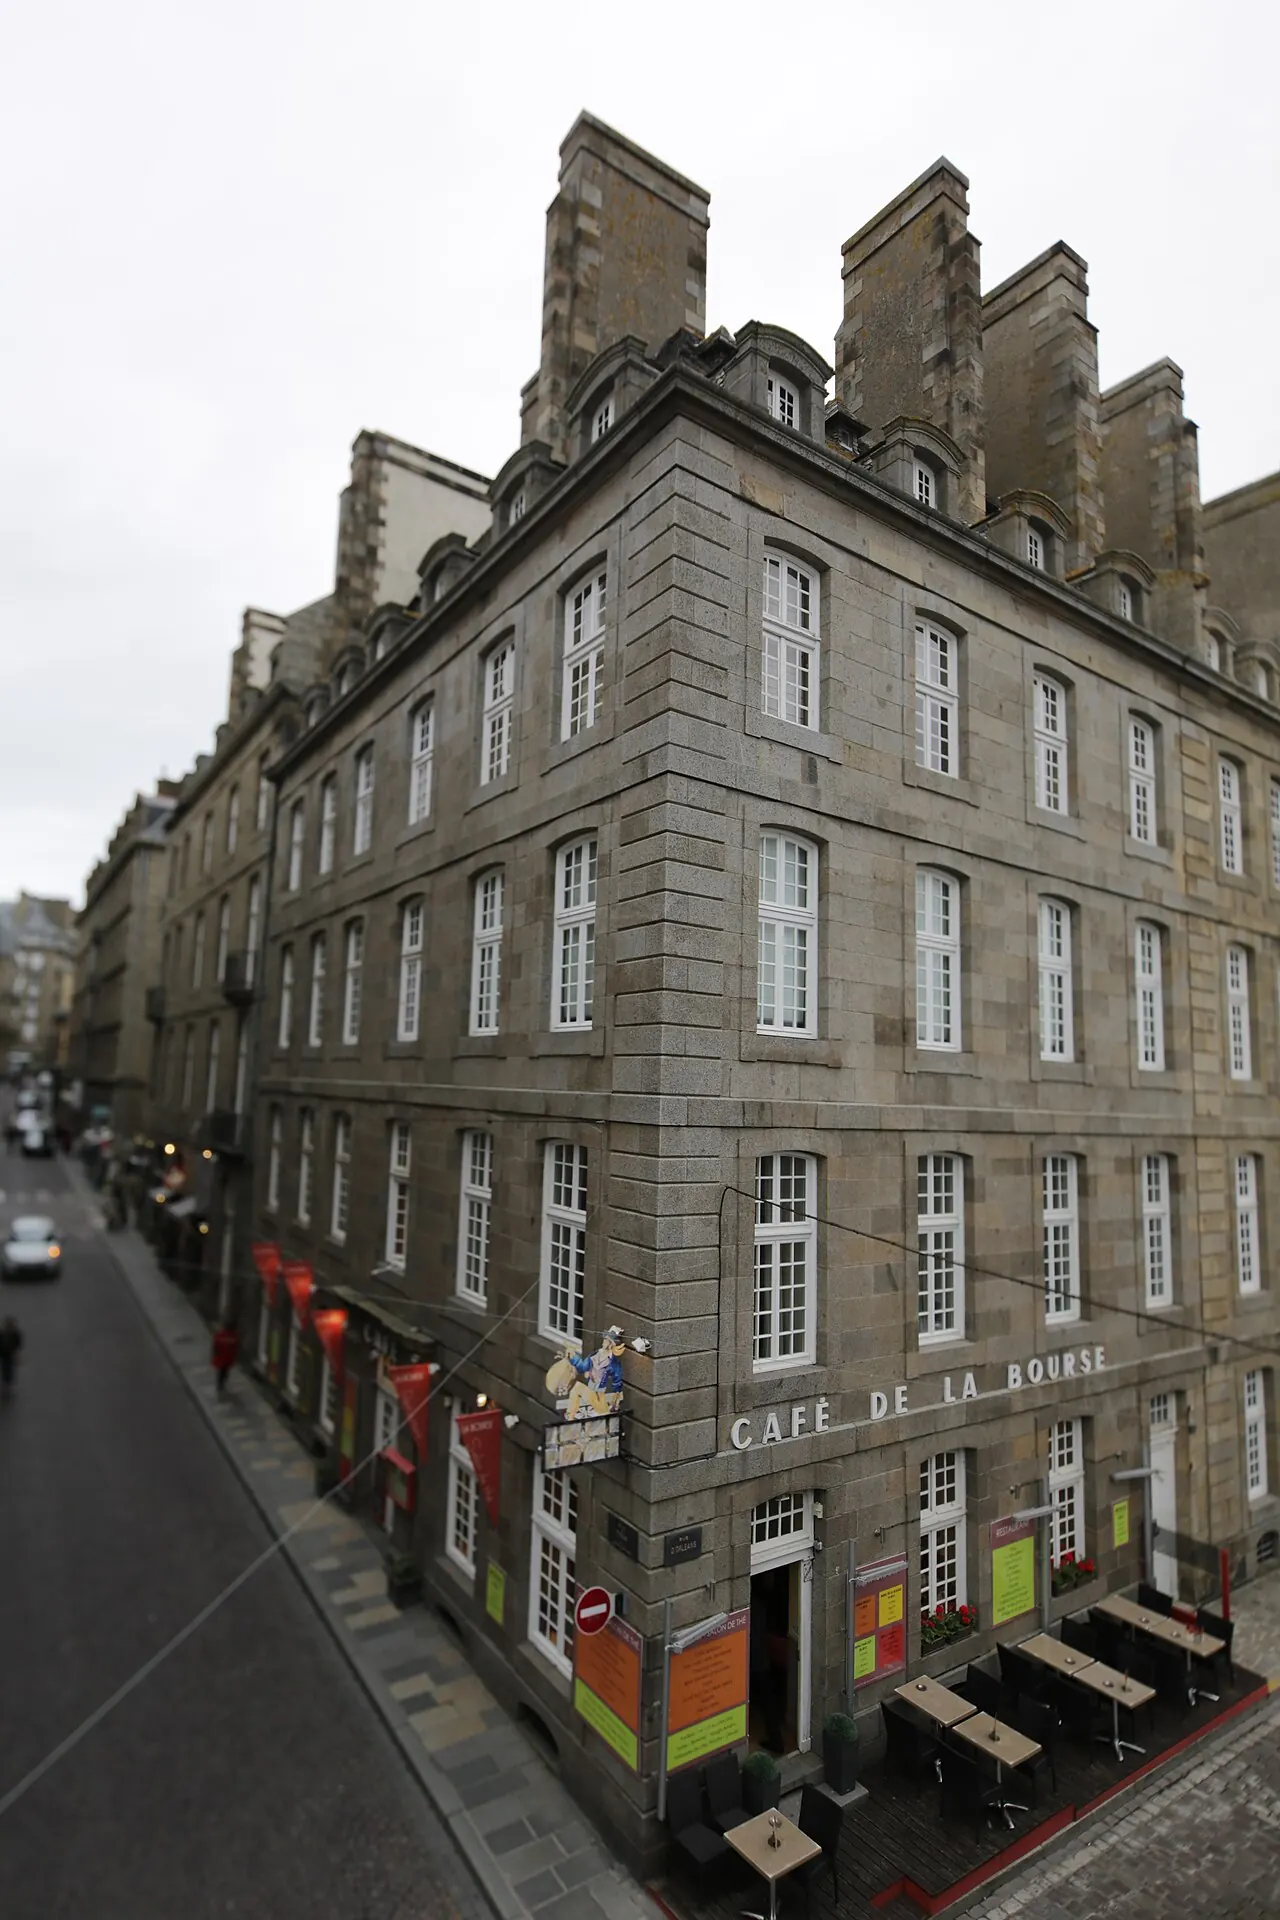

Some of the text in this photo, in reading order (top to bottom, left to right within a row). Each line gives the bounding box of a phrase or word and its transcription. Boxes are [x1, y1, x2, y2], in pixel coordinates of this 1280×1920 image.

[730, 1346, 1106, 1450] CAFÉ DE LA BOURSE
